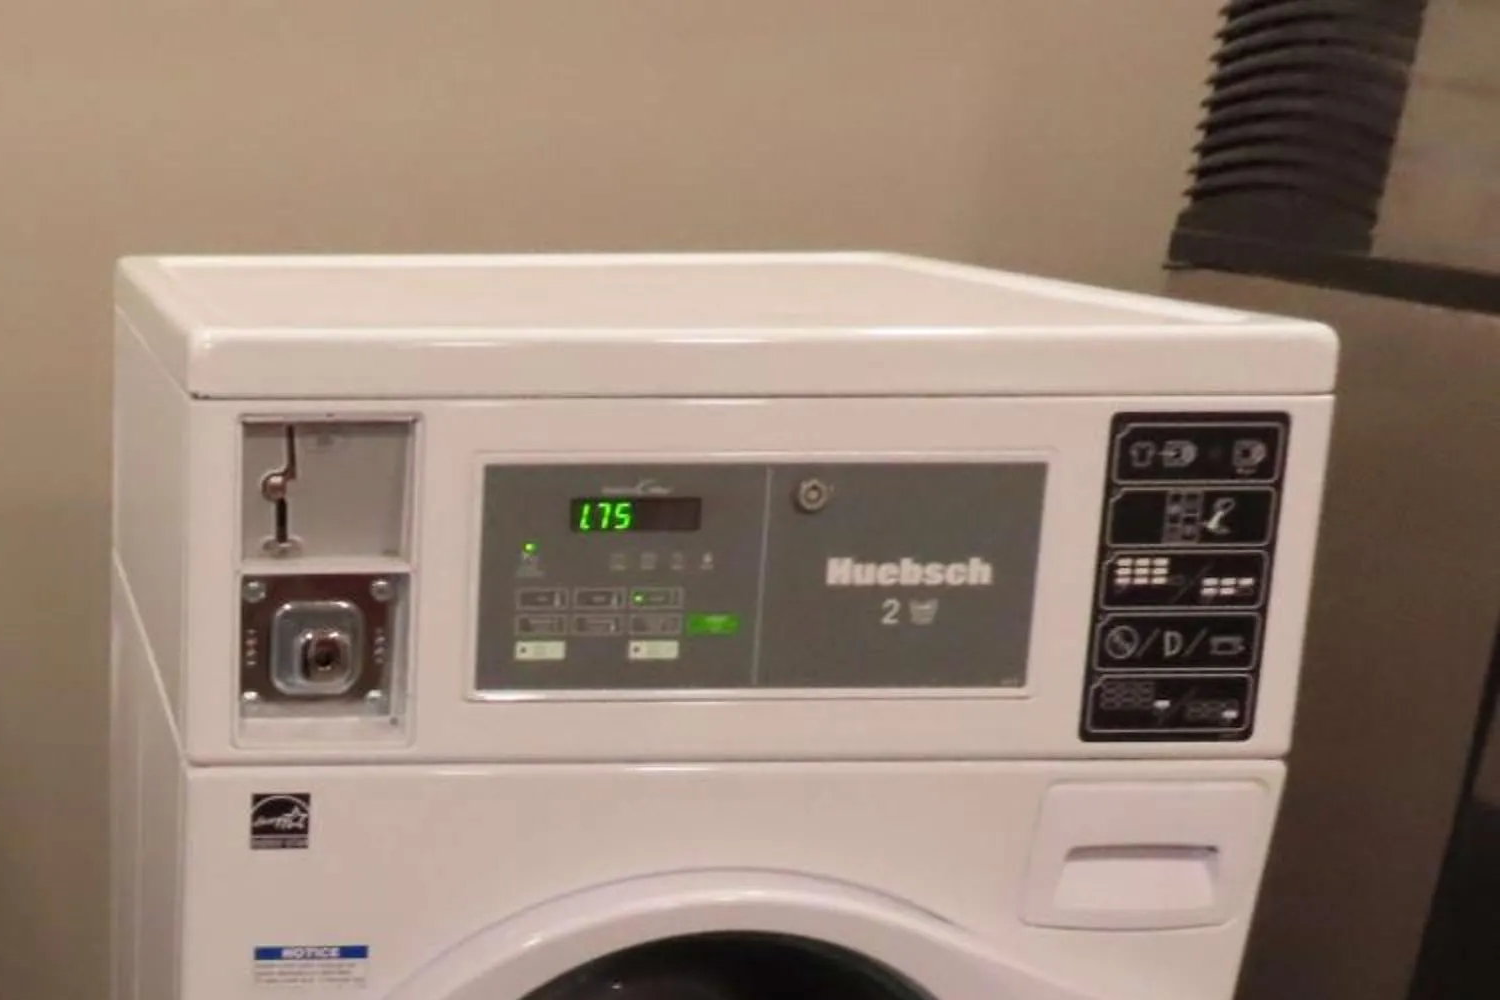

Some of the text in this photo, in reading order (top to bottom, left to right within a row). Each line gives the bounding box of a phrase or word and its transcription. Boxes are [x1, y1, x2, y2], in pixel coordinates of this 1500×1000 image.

[826, 557, 992, 587] Huebsch
[881, 598, 901, 625] 2
[281, 946, 339, 960] NOTICE
